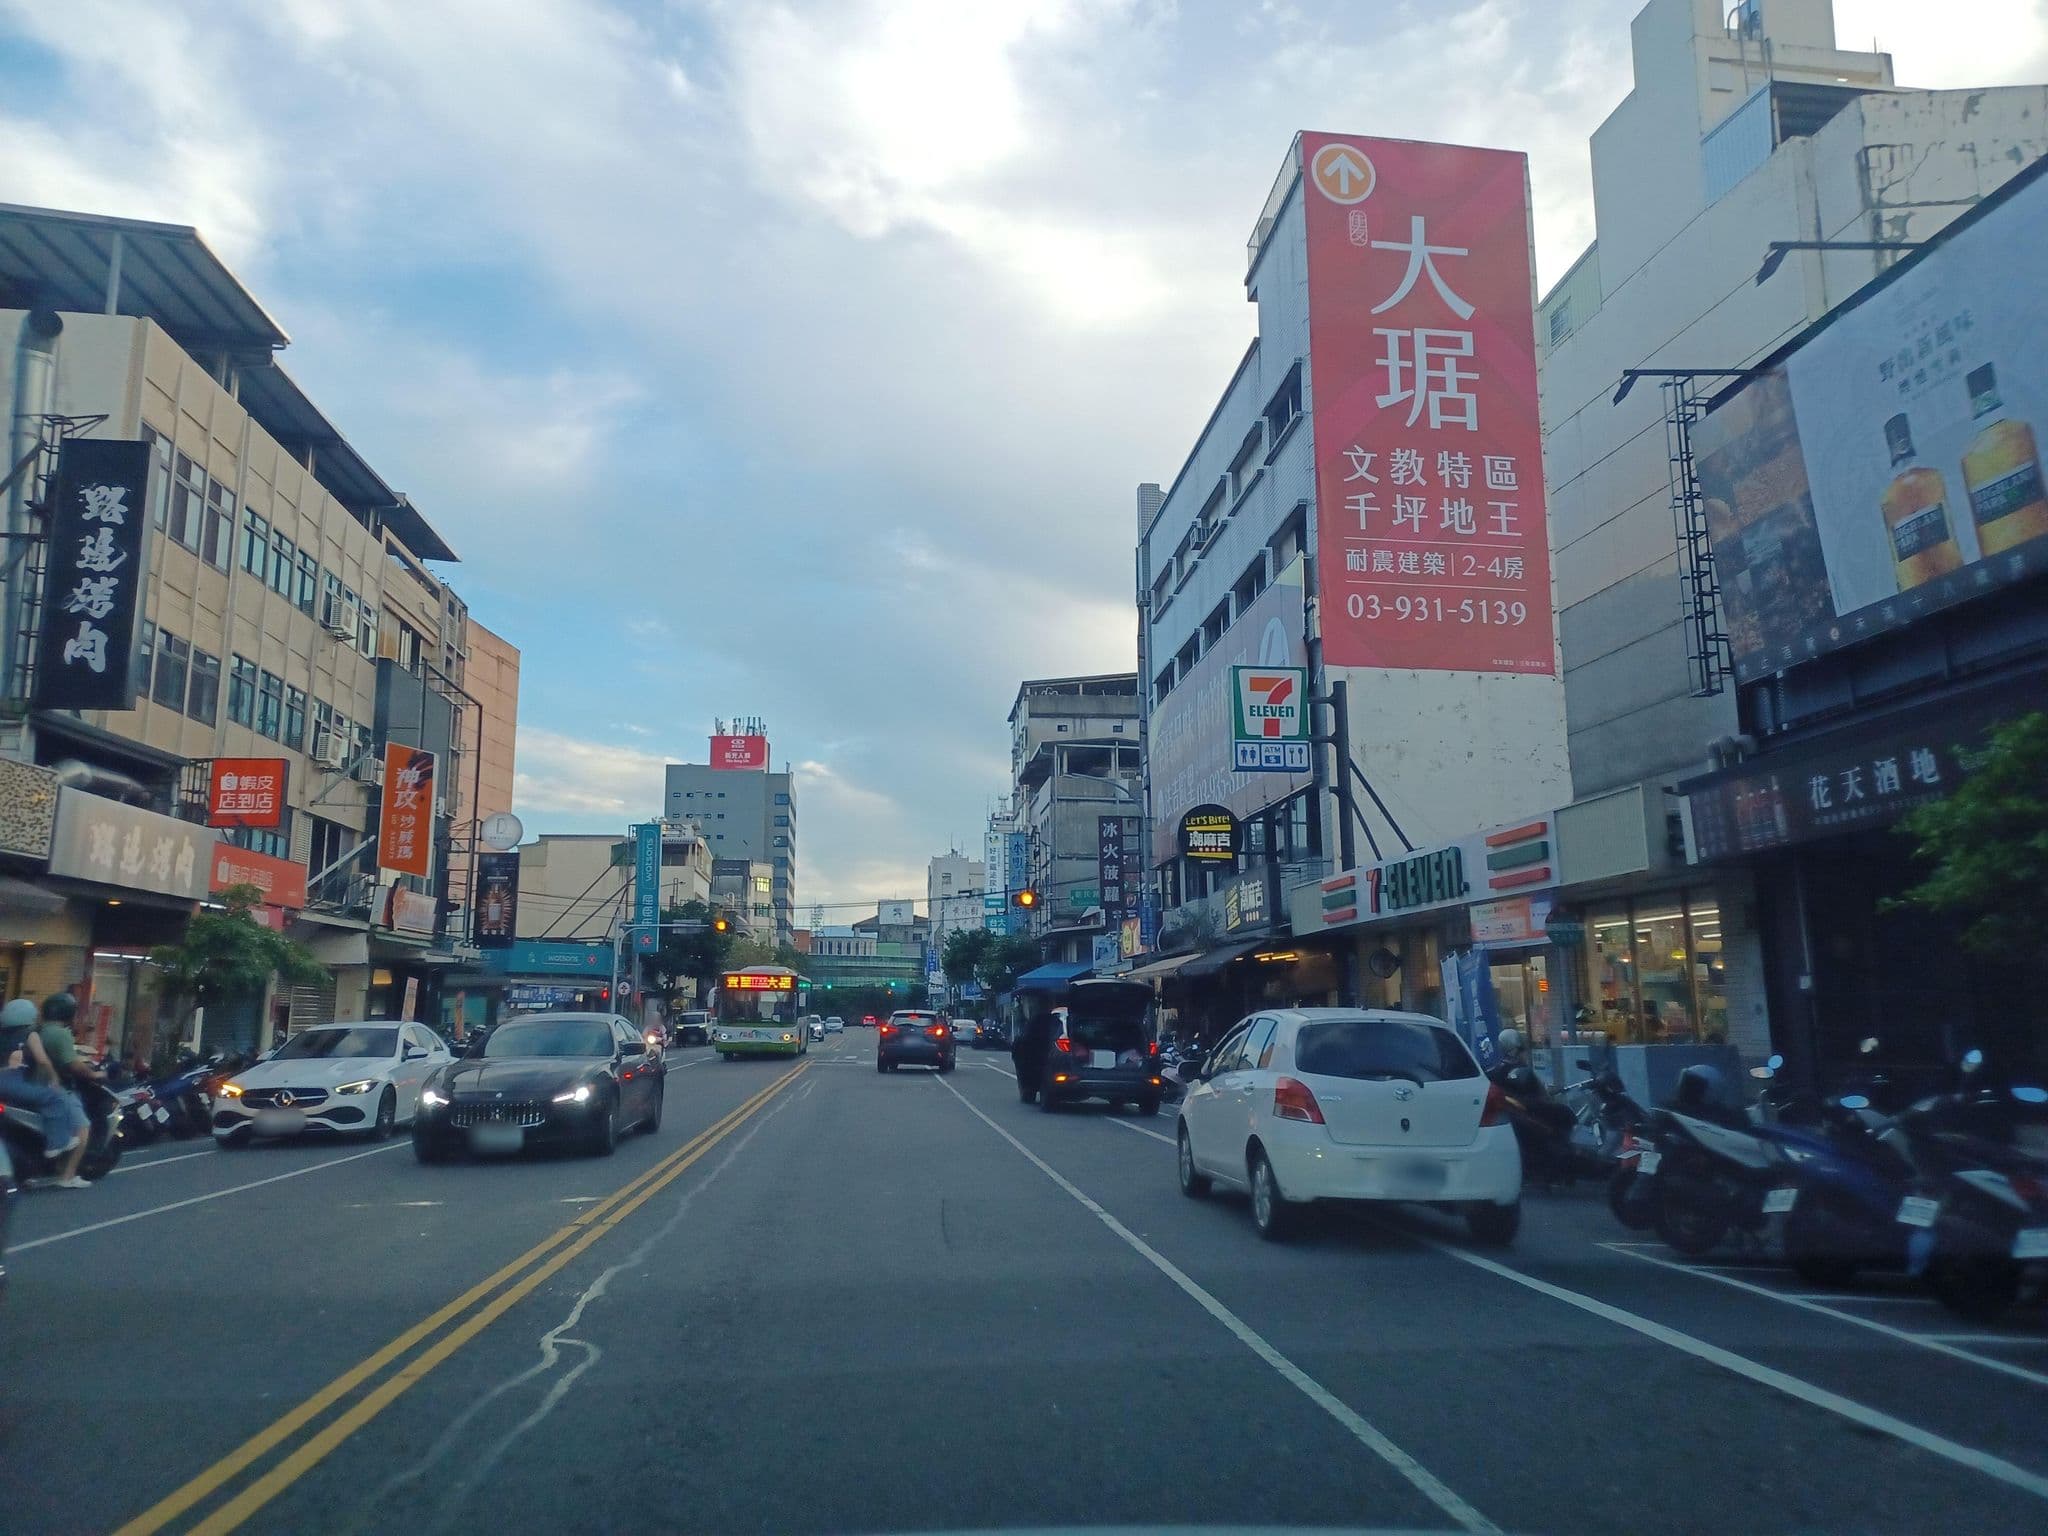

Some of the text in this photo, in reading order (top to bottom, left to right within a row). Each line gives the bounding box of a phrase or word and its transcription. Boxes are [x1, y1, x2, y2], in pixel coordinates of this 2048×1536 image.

[1371, 216, 1480, 431] 大琚
[1343, 445, 1519, 491] 文教特區
[1344, 492, 1522, 537] 千坪地王
[1346, 549, 1525, 580] 耐震建築 2-4房
[1347, 594, 1528, 626] 03-931-5139
[1264, 746, 1281, 755] ATM
[240, 775, 275, 791] 蝦皮
[1808, 747, 1941, 810] 花天酒地
[218, 793, 274, 809] 店到店
[1189, 831, 1231, 847] 潮麻吉
[1103, 823, 1120, 902] 冰火菠蘿
[548, 953, 579, 963] watsons
